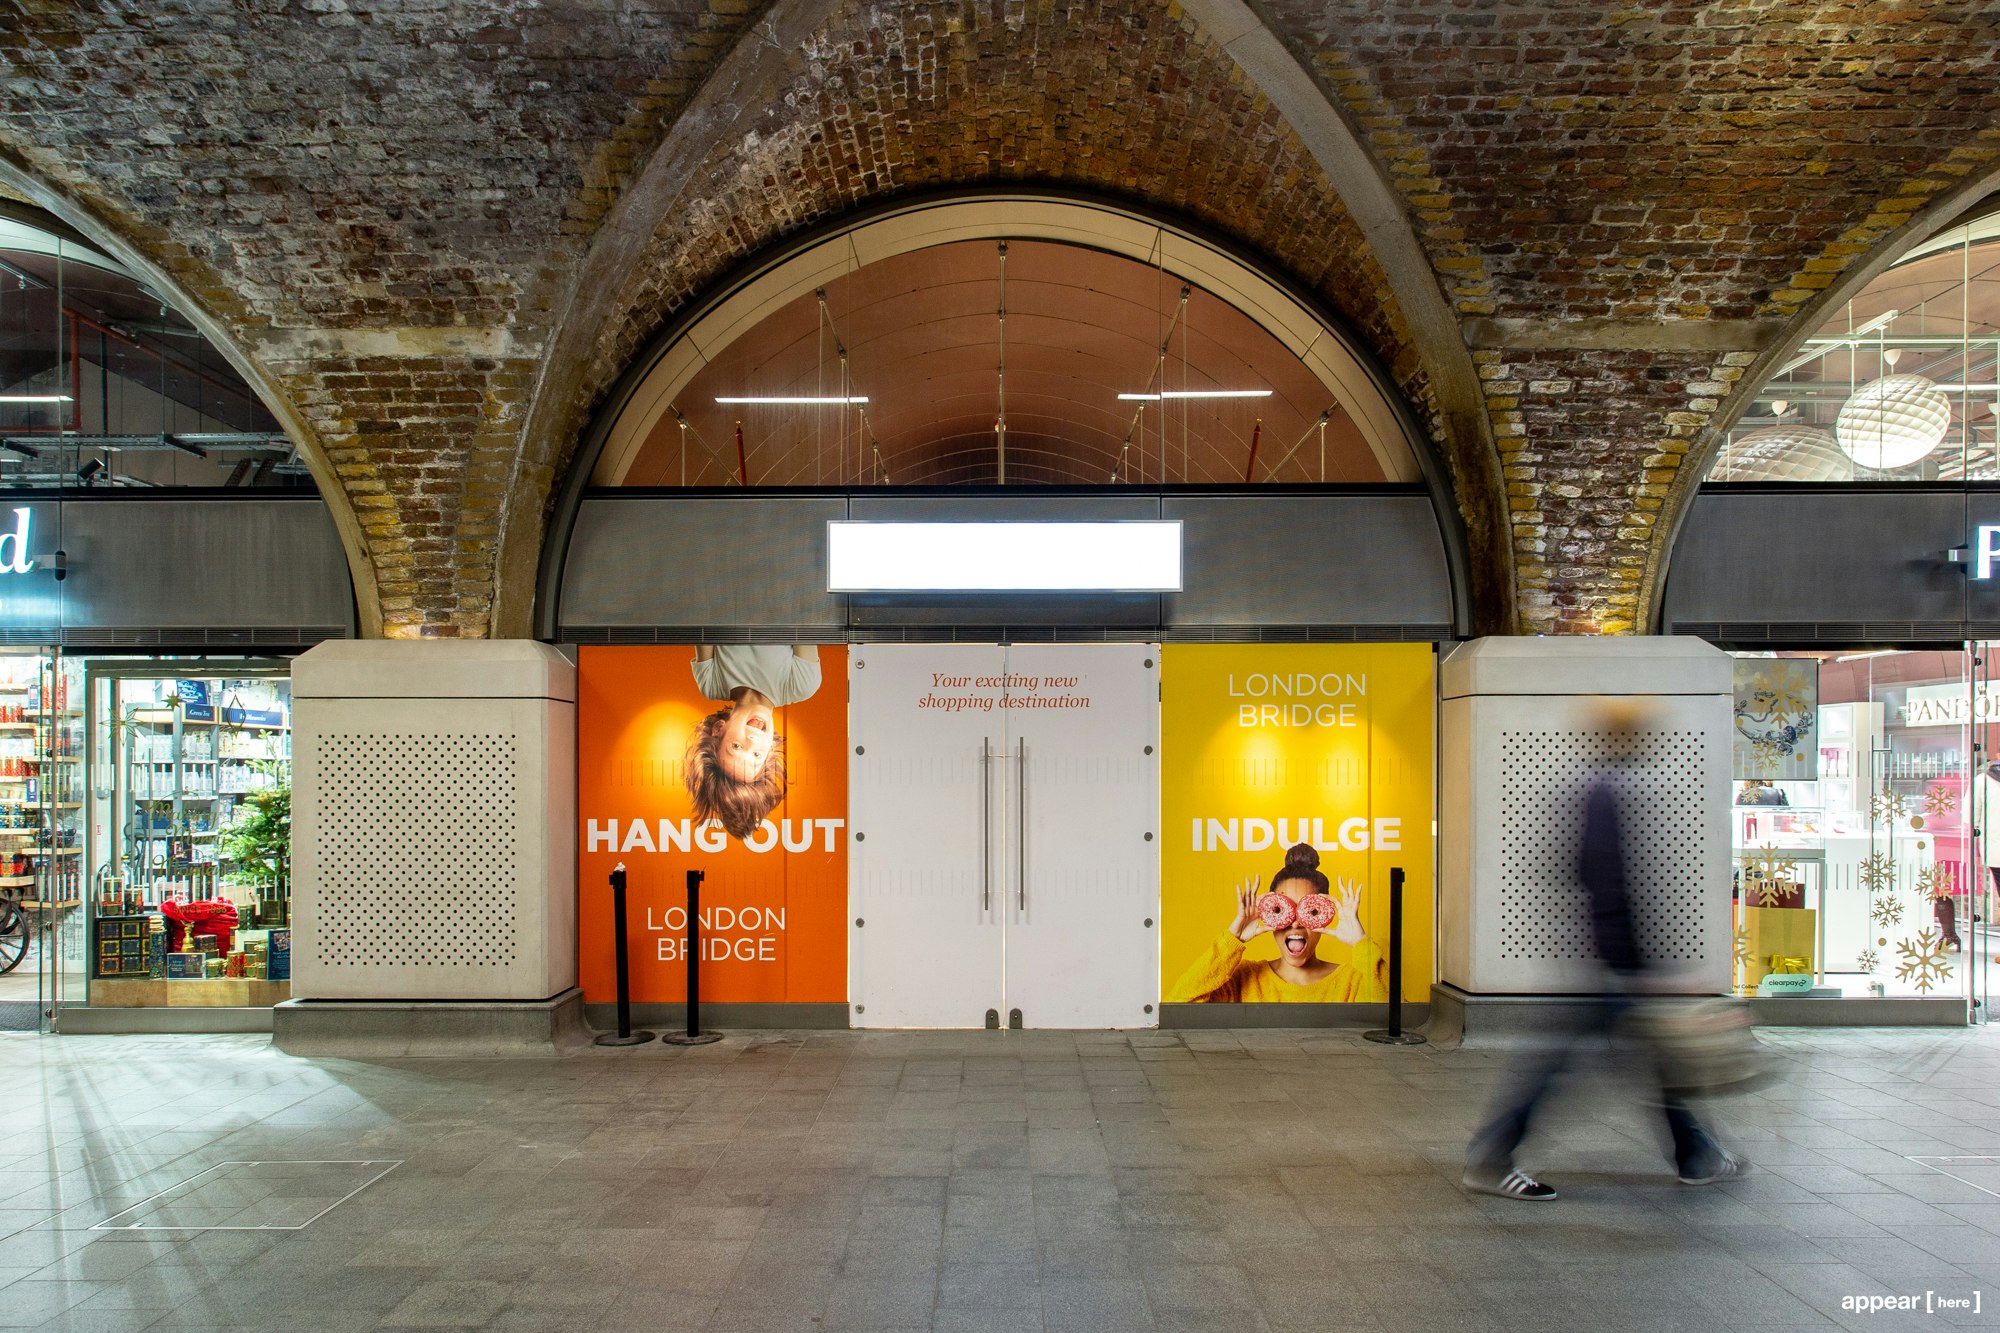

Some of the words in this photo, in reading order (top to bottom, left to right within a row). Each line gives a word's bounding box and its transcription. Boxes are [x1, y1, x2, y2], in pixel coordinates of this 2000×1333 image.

[931, 673, 971, 688] Your
[975, 673, 1039, 691] exciting
[1043, 676, 1079, 688] new
[1229, 673, 1367, 697] LONDON
[918, 693, 994, 712] shopping
[998, 693, 1091, 709] destination
[1239, 703, 1357, 728] BRIDGE
[587, 818, 727, 853] HANG
[744, 818, 845, 853] OUT
[1192, 817, 1402, 852] INDULGE
[1768, 979, 1799, 987] clearpay
